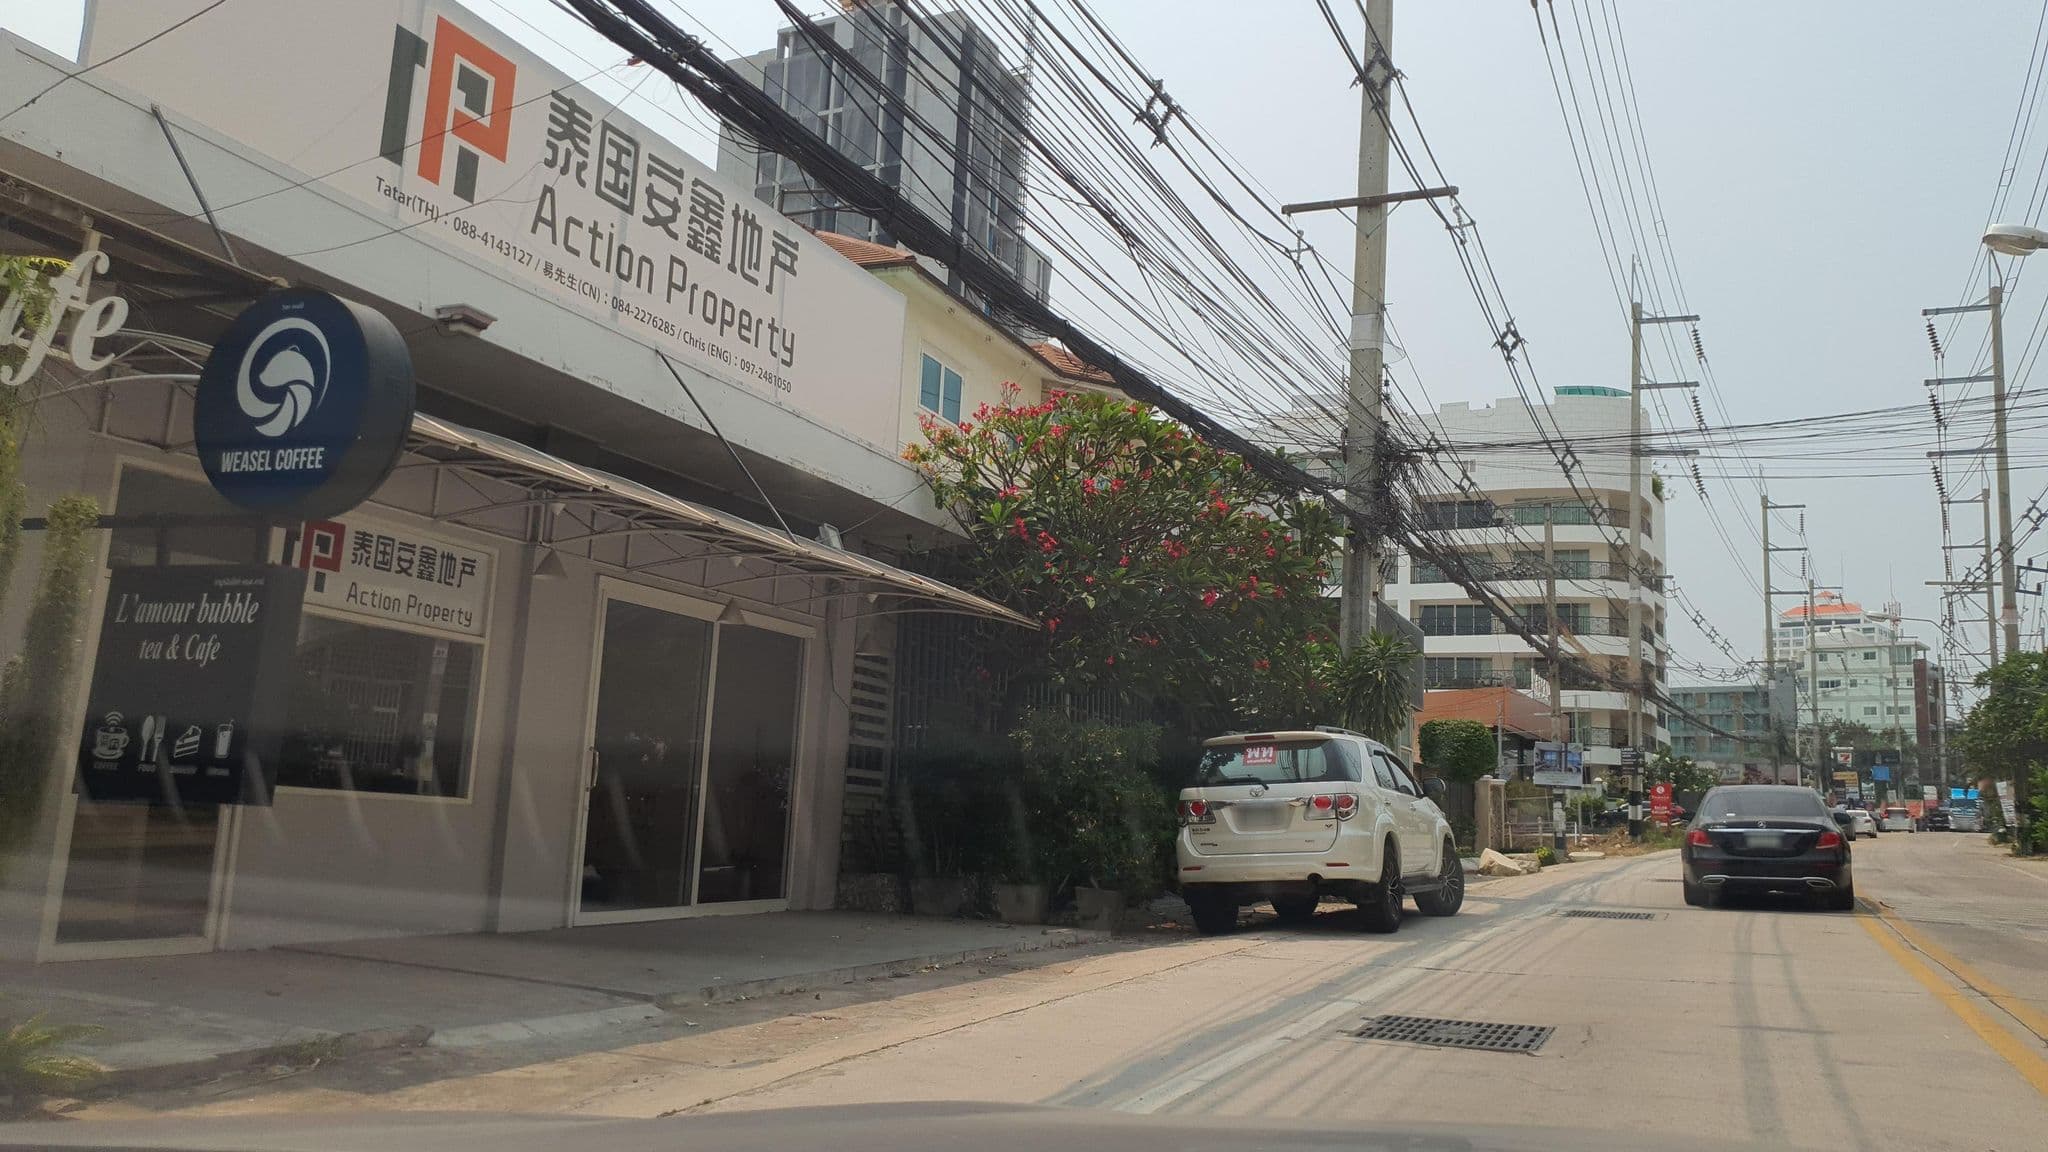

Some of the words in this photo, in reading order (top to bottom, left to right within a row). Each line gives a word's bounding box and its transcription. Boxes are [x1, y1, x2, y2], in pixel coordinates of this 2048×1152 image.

[543, 89, 800, 295] 泰国安鑫地产
[376, 175, 440, 223] Tatar(TH)
[453, 216, 533, 267] 088-4143127
[543, 260, 601, 303] 易先生(CN)
[611, 296, 676, 337] 084-2276285
[683, 331, 706, 352] Chris
[707, 342, 732, 366] (ENG)
[740, 358, 792, 393] 097-2481050
[530, 184, 655, 295] Action
[666, 254, 796, 368] Property
[221, 450, 272, 473] WEASEL
[275, 447, 325, 471] COFFEE
[351, 530, 477, 588] 泰国安鑫地产
[114, 593, 195, 623] L'amour
[197, 593, 260, 624] bubble
[346, 582, 401, 613] Action
[406, 594, 473, 628] Property
[139, 640, 163, 660] tea
[165, 633, 181, 660] &
[185, 633, 221, 667] Cafe
